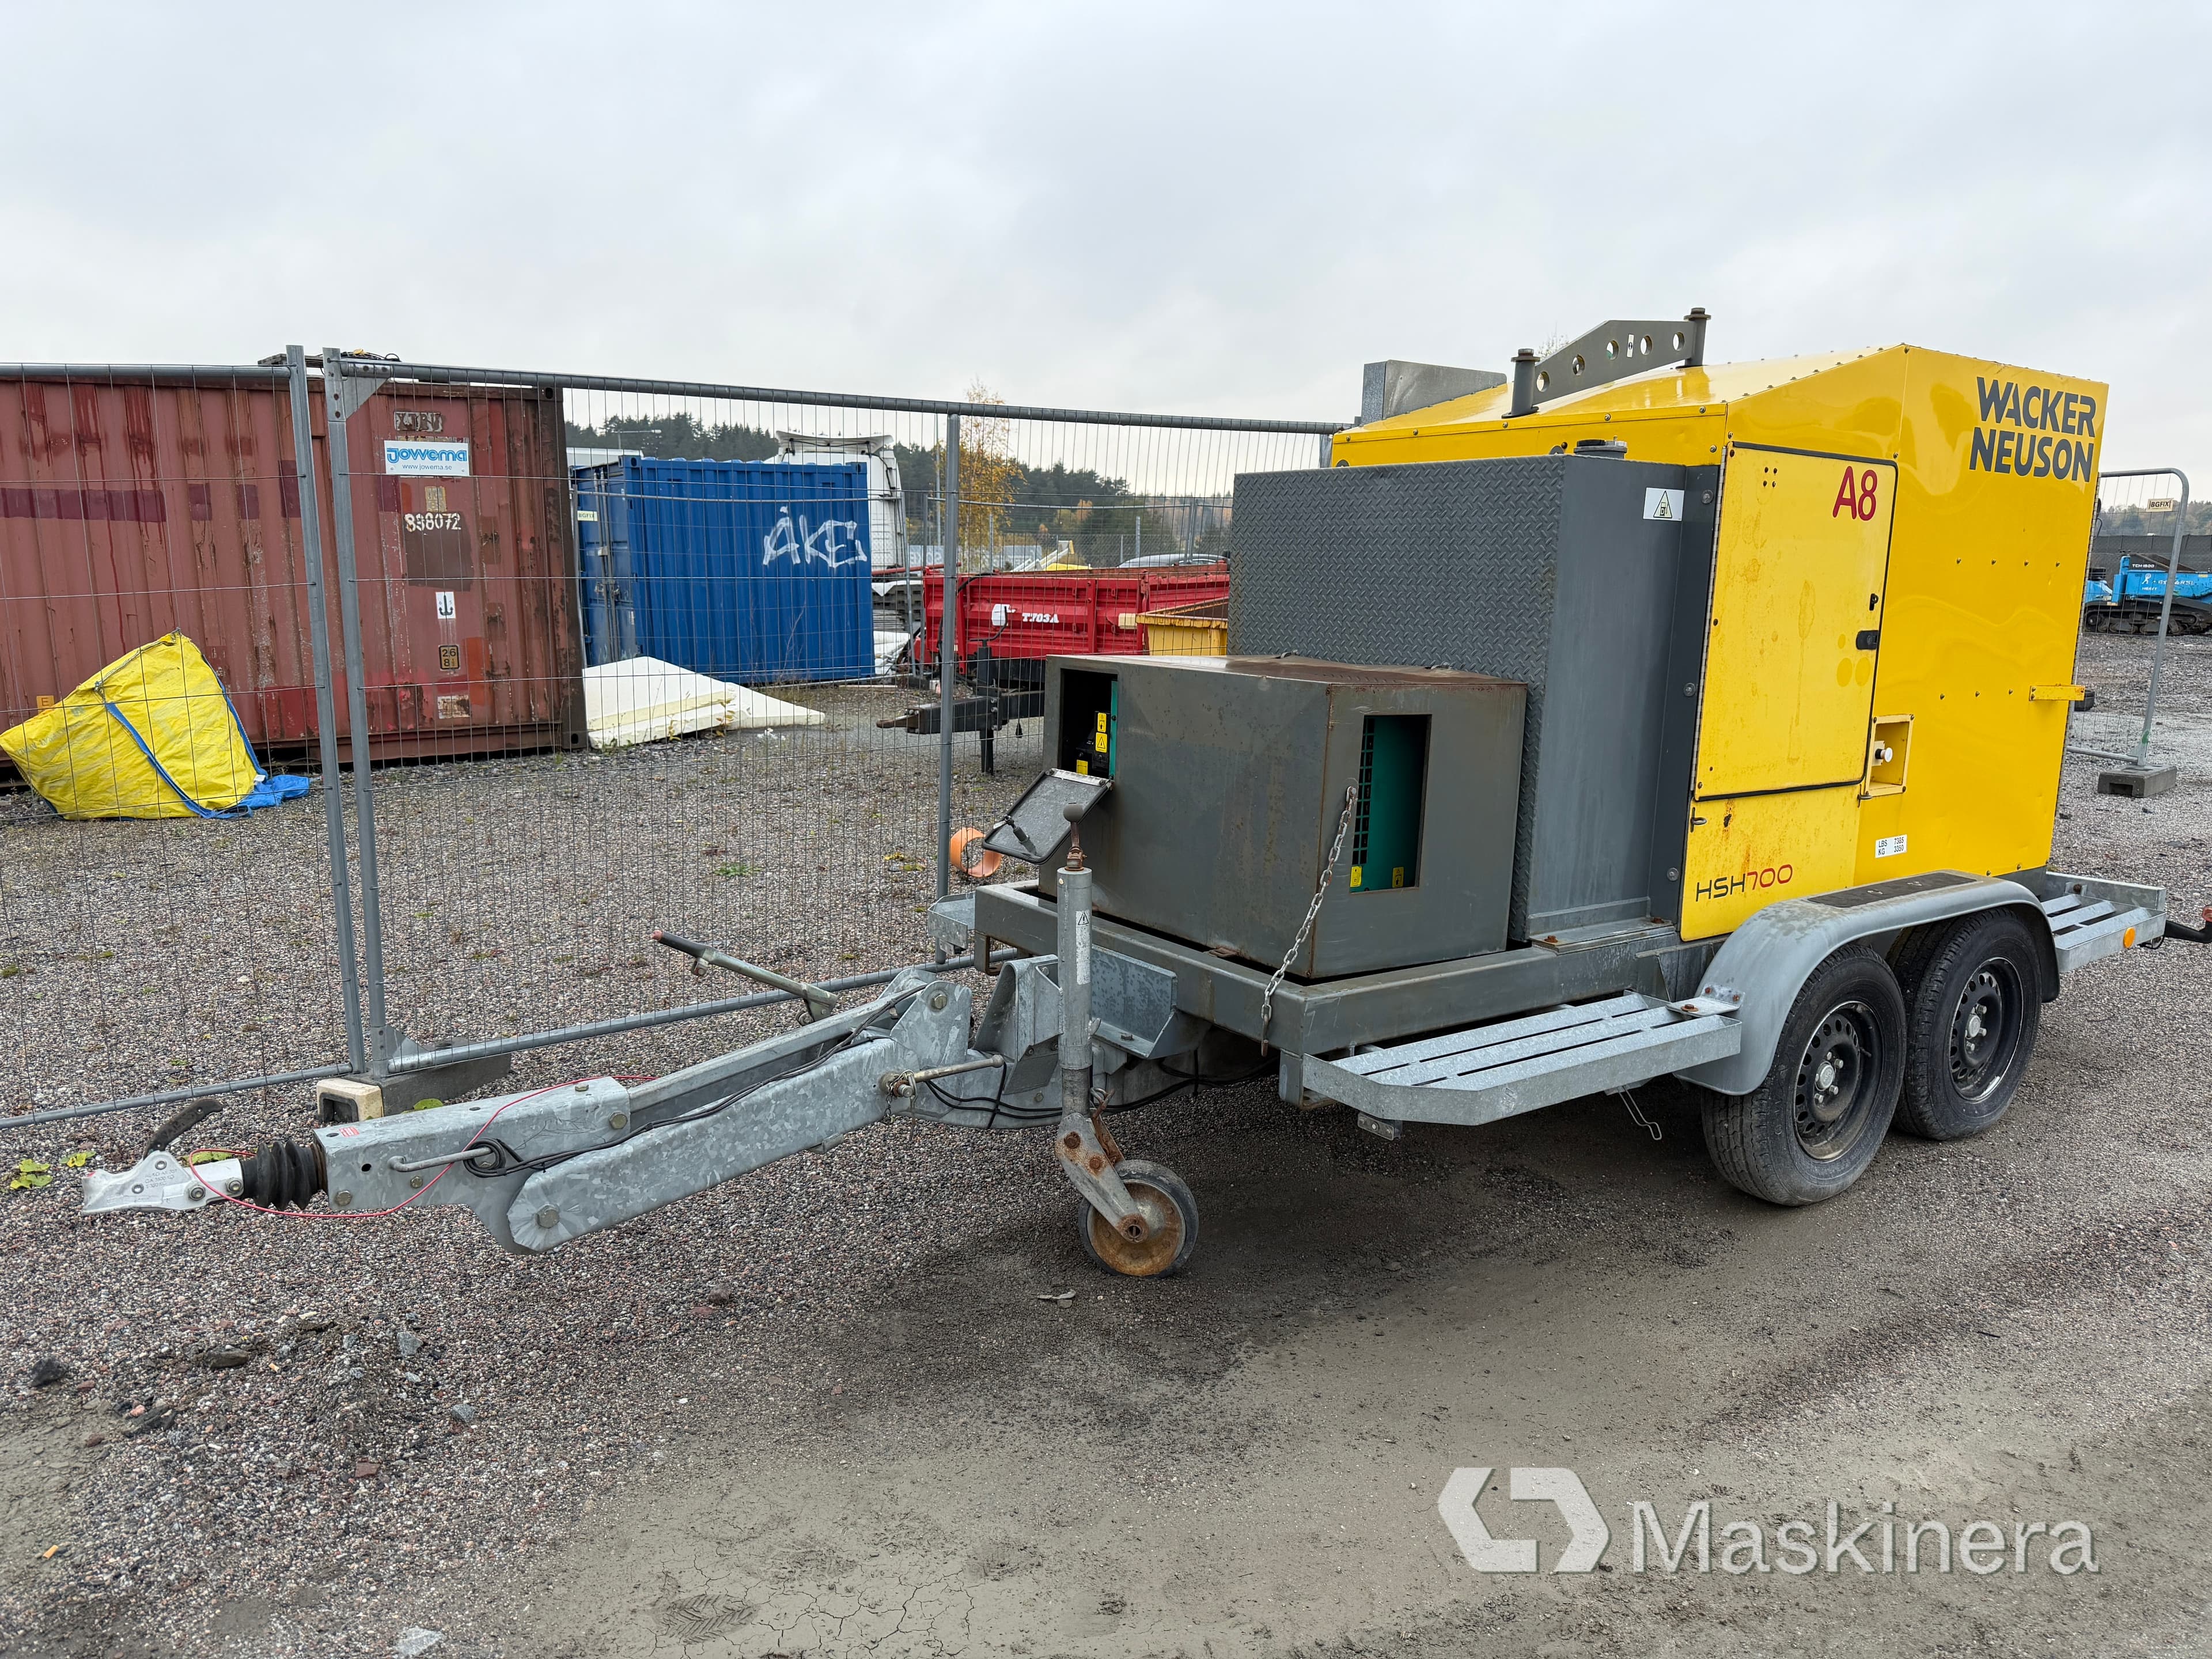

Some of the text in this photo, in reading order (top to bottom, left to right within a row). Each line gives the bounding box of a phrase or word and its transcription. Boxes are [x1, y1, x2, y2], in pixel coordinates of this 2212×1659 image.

[1976, 376, 2096, 438] WACKER
[1969, 427, 2094, 483] NEUSON
[1832, 465, 1878, 521] A8
[1878, 839, 1888, 848] LBS
[1878, 847, 1885, 856] KG
[1696, 864, 1793, 902] HSH700
